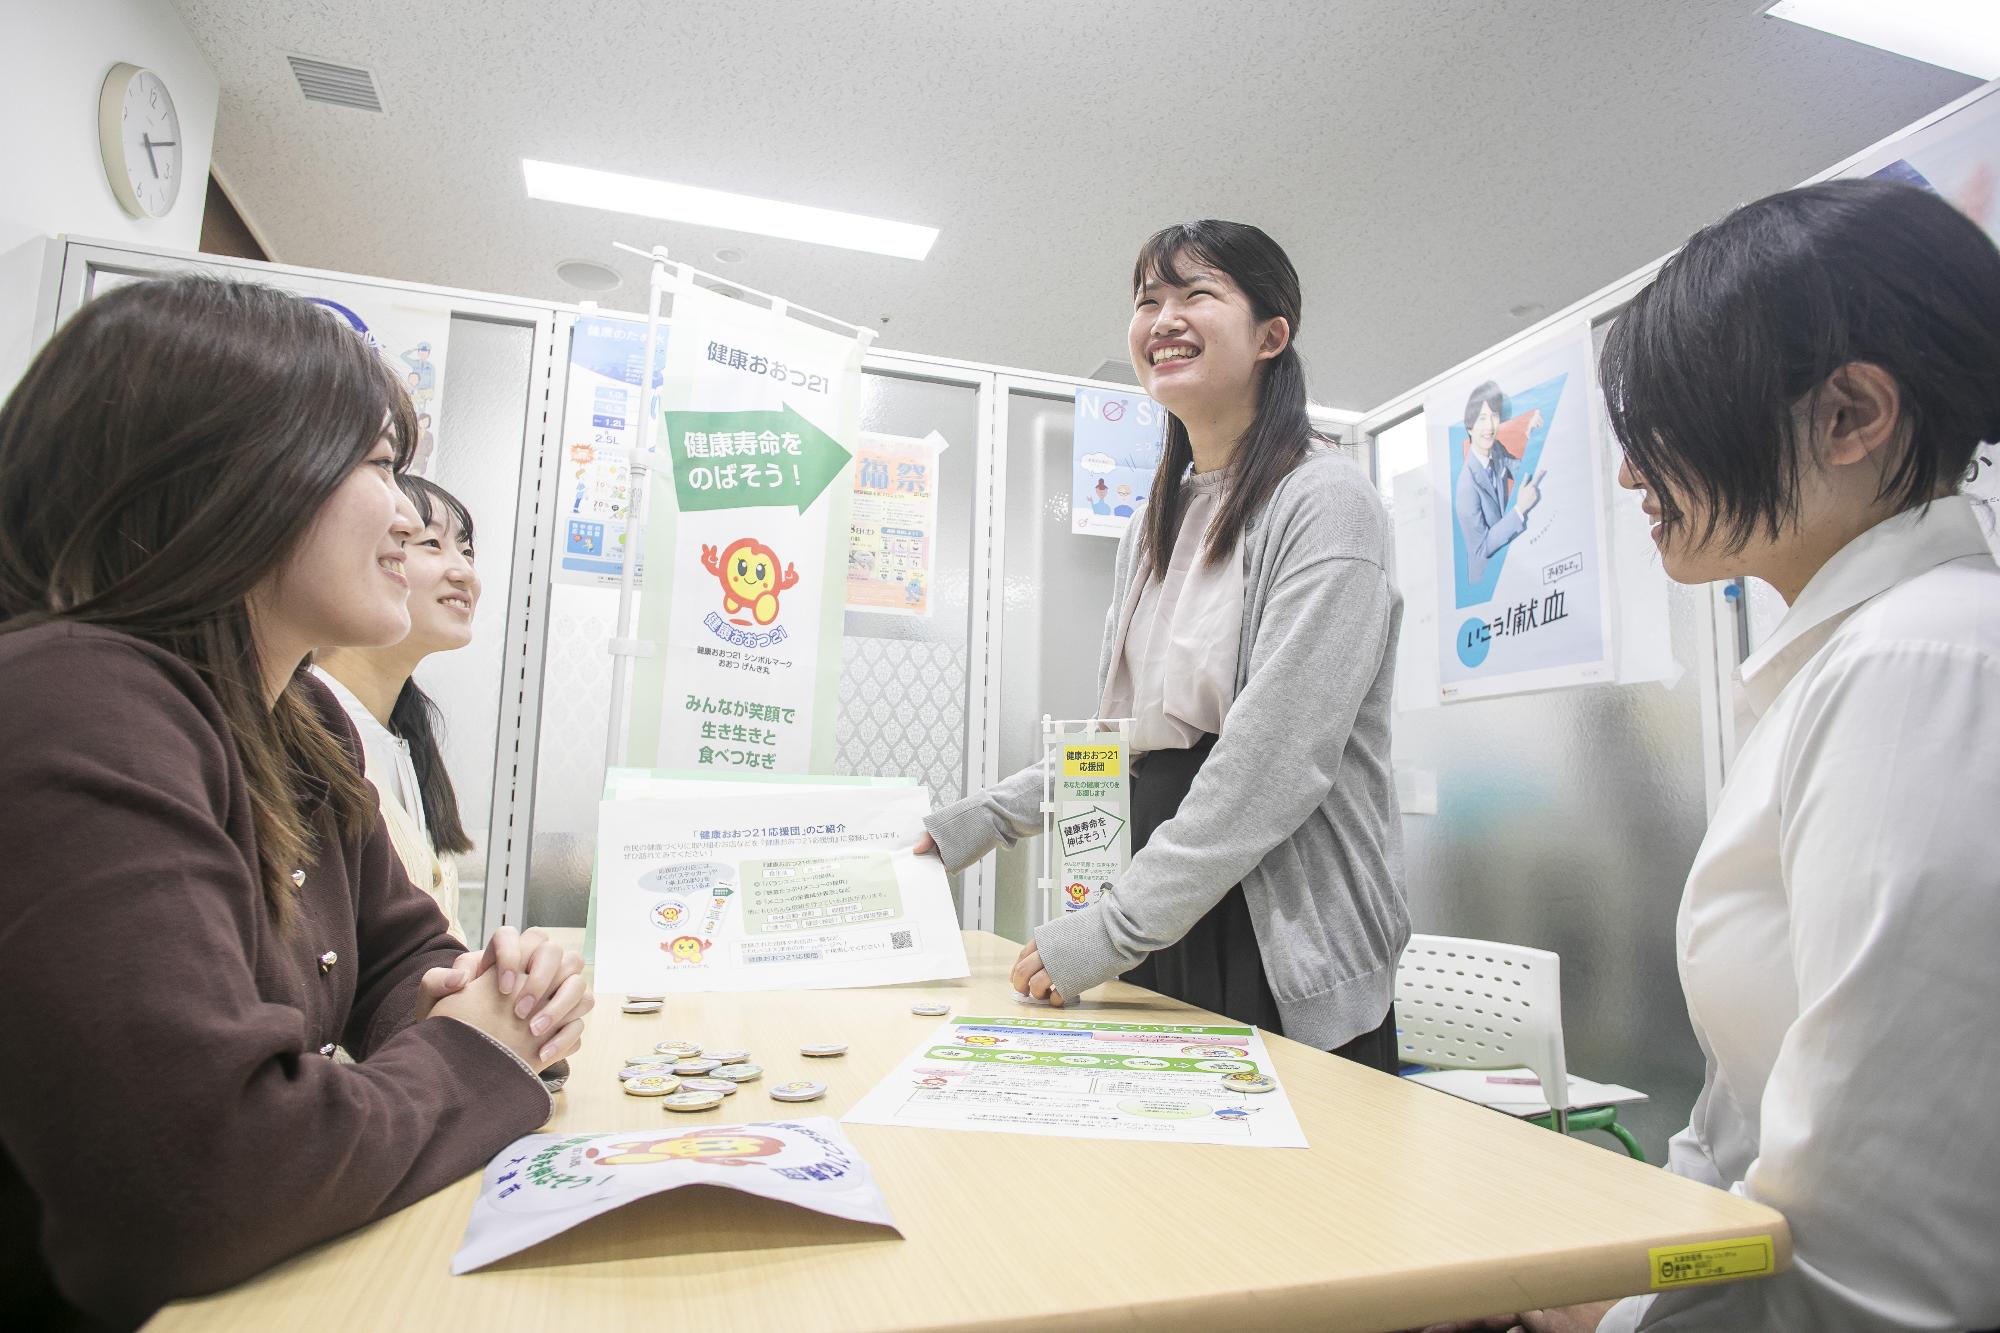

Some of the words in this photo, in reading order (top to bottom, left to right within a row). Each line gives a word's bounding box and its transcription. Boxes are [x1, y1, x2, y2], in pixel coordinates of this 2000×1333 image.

[149, 87, 158, 110] 12
[707, 339, 829, 395] 健康おおつ21
[683, 429, 803, 459] 健康寿命を
[687, 462, 802, 490] のばそう！
[703, 611, 788, 649] 健康おおつ21
[696, 645, 741, 660] 健康おおつ21
[743, 652, 793, 669] シンボルマーク
[718, 658, 740, 670] おおつ
[741, 662, 771, 675] げんき丸
[685, 694, 796, 724] みんなが笑顔で
[700, 720, 777, 746] 生き生きと
[698, 745, 777, 770] 食べつなぎ
[1066, 750, 1119, 761] 健康おおつ21
[1079, 761, 1105, 772] 応援団
[692, 823, 847, 840] 「健康おおつ21応援団」のご紹介
[1063, 816, 1107, 838] 健康寿命を
[1066, 828, 1107, 848] 伸ばそう！
